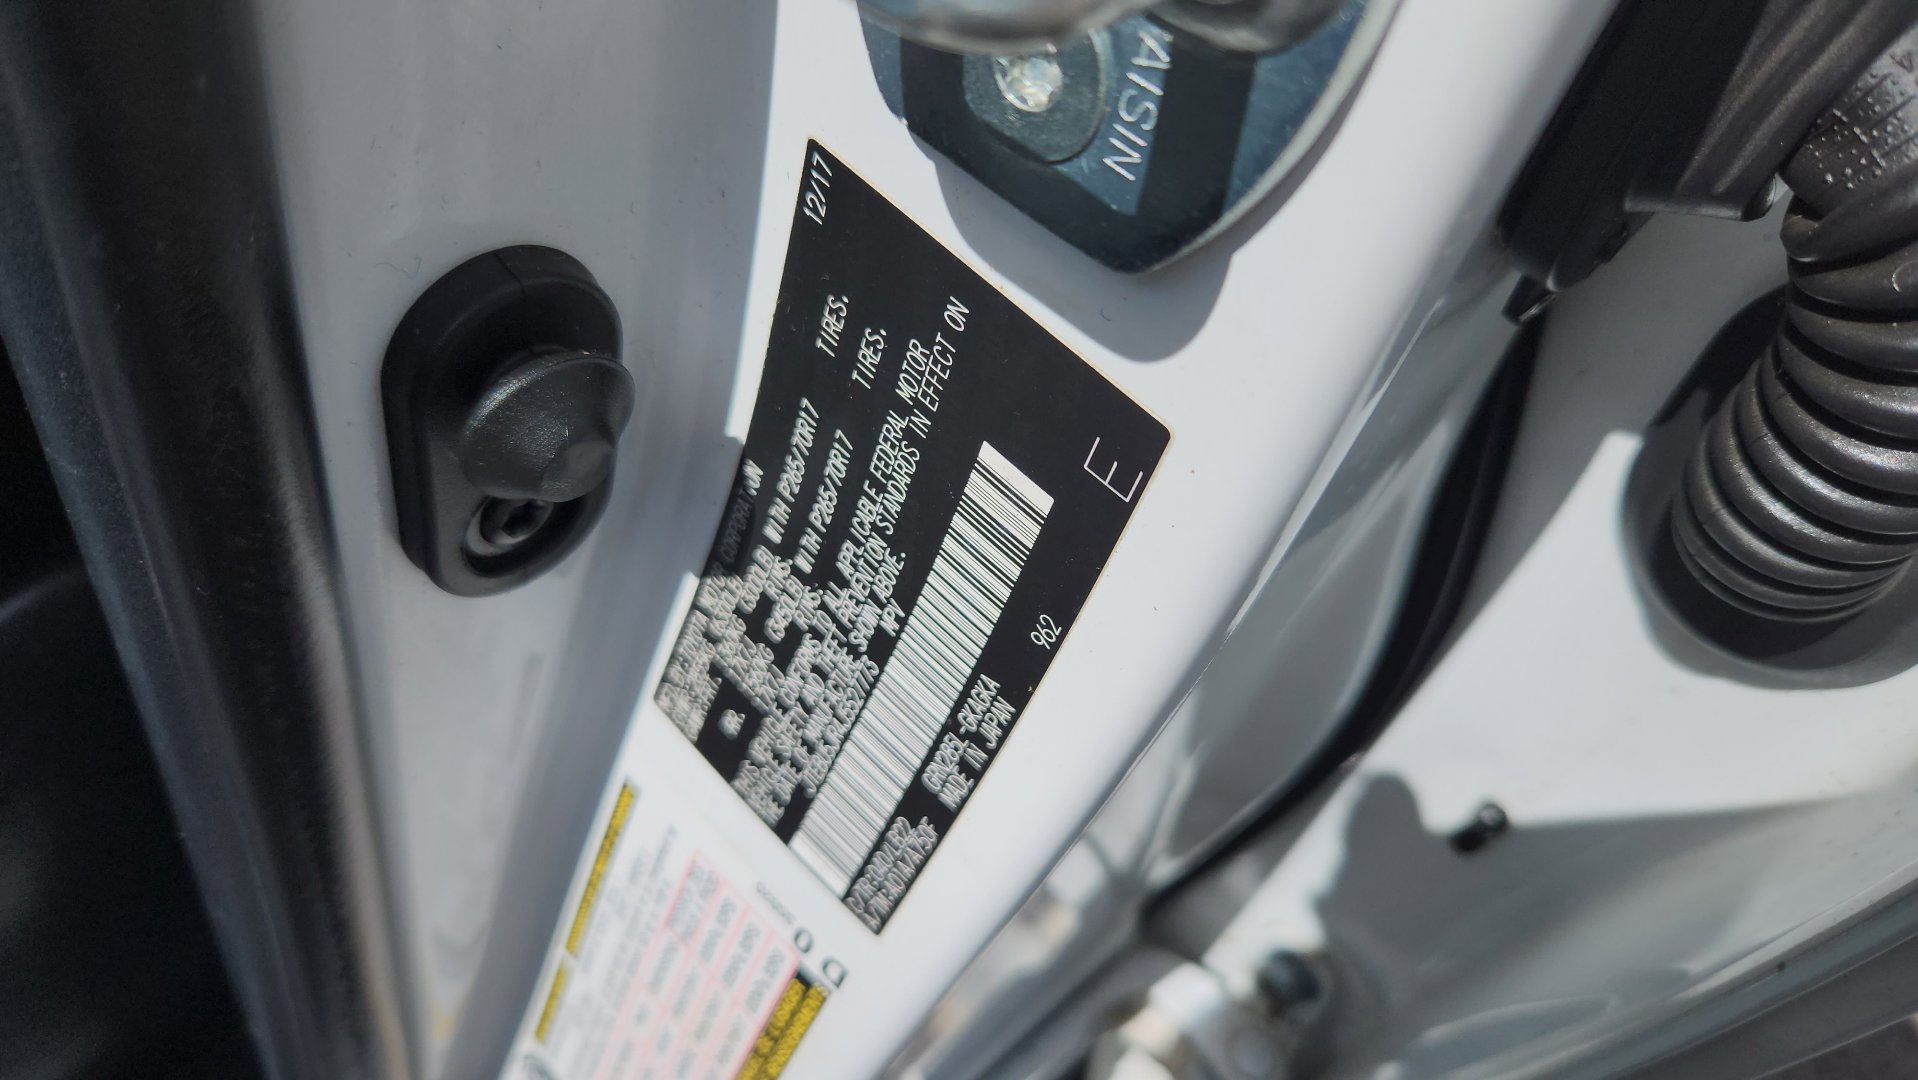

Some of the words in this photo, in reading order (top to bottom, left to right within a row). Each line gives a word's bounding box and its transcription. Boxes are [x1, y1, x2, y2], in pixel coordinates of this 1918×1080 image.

[1102, 30, 1171, 181] AISIN
[803, 152, 832, 224] 12/17
[944, 296, 969, 331] ON
[895, 339, 930, 405] MOTOR
[917, 332, 956, 412] EFFECT
[763, 497, 791, 544] WITH
[777, 398, 819, 502] P265/70R17
[816, 295, 848, 357] TIRES.
[792, 528, 822, 574] WITH
[809, 429, 853, 532] P265/70R17
[852, 328, 886, 389] TIRES.
[870, 410, 909, 484] FEDERAL
[909, 409, 931, 438] IN
[874, 441, 920, 535] STANDARDS
[1084, 437, 1143, 502] E
[836, 480, 885, 584] APPLICABLE
[820, 581, 849, 617] ALL
[836, 530, 888, 633] PREVENTION
[846, 594, 884, 656] SHOWN
[869, 548, 906, 603] ABOVE.
[879, 598, 905, 637] MPV
[809, 604, 833, 641] TO
[1031, 615, 1062, 649] 962
[922, 674, 1000, 796] GRN285L-GKAGKA
[939, 765, 974, 810] MADE
[964, 743, 988, 770] IN
[979, 696, 1016, 749] JAPAN
